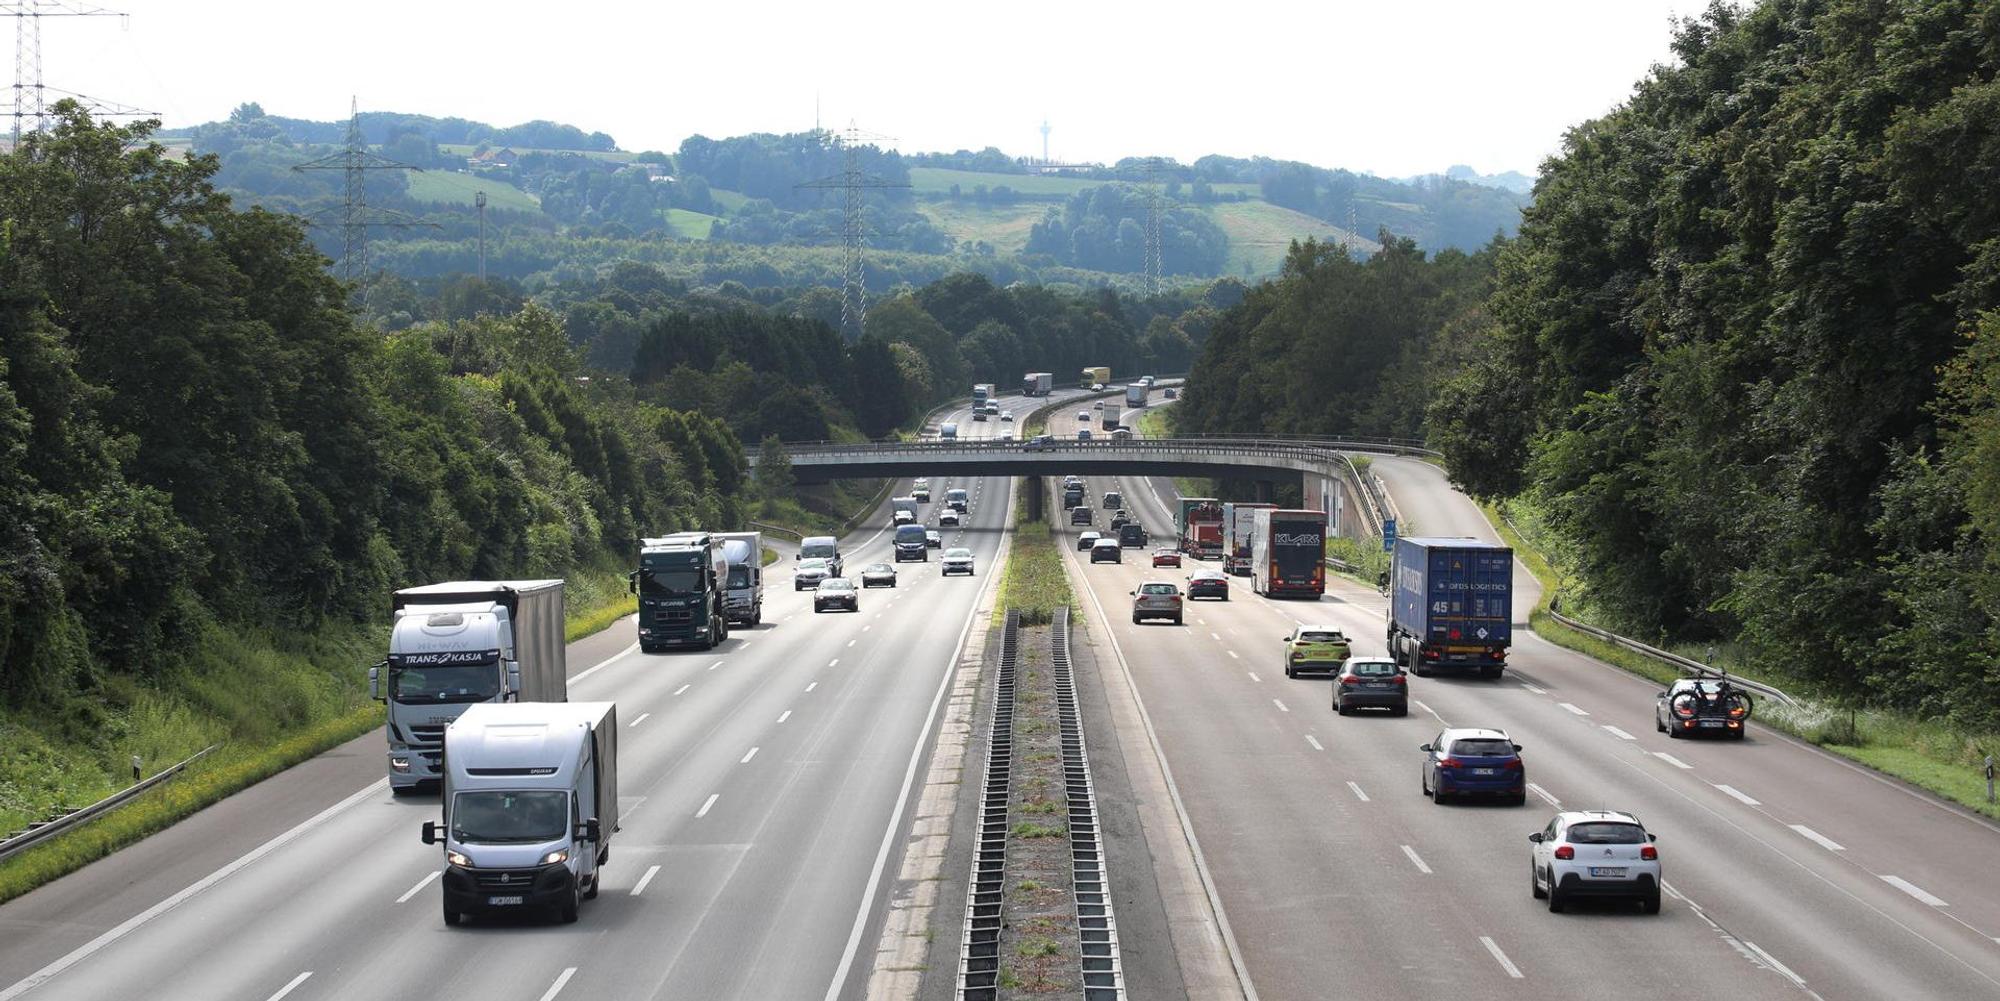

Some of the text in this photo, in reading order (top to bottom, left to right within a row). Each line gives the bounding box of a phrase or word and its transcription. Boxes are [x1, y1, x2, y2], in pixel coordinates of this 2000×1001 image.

[1432, 601, 1448, 613] 45
[405, 653, 482, 664] TRANS KASJA
